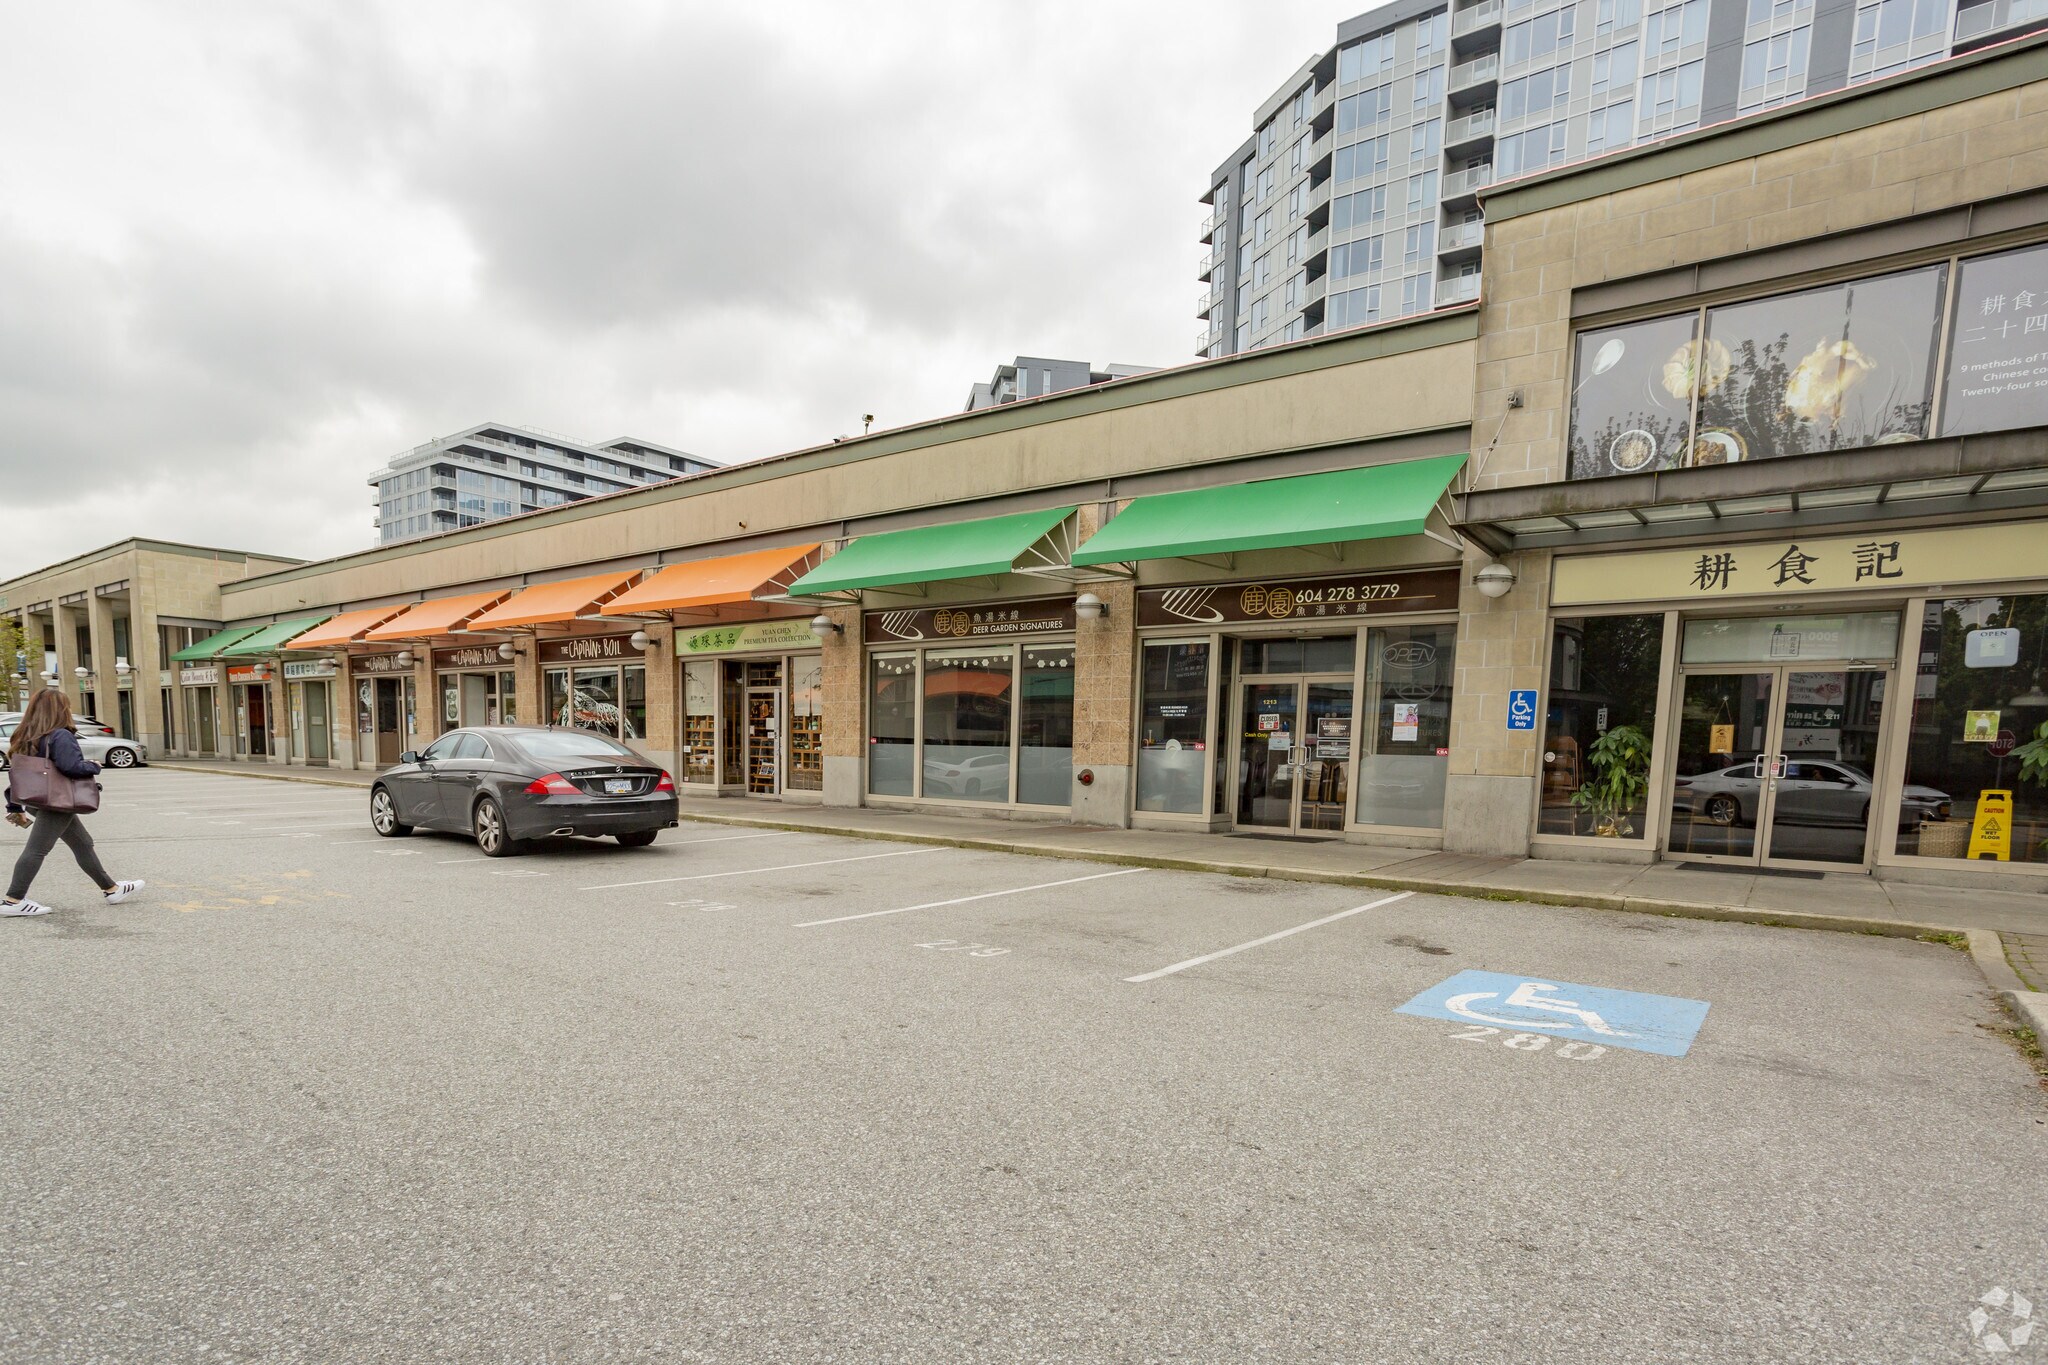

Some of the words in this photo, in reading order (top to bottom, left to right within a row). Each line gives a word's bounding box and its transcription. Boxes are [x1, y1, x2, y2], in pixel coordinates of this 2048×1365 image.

[1961, 365, 1968, 373] 9
[1971, 358, 2022, 371] methods
[2025, 354, 2039, 363] of
[2040, 352, 2048, 361] T
[1983, 369, 2029, 382] Chinese
[2033, 366, 2048, 375] co
[1961, 382, 2031, 397] Twenty-four
[1690, 541, 1903, 591] 耕食記
[1241, 586, 1293, 617] 鹿園
[1296, 589, 1323, 603] 604
[1327, 587, 1355, 601] 278
[1361, 584, 1400, 599] 3779
[1296, 603, 1368, 617] 魚湯米線
[935, 611, 969, 635] 鹿園
[972, 625, 989, 634] DEER
[990, 622, 1018, 633] GARDEN
[1020, 620, 1063, 630] SIGNATURES
[561, 646, 569, 654] THE
[603, 638, 622, 656] BOIL
[744, 637, 767, 645] PREMIUM
[768, 636, 779, 644] TEA
[779, 634, 811, 643] COLLECTION
[484, 648, 498, 663] BOIL
[1383, 647, 1437, 662] OPEN
[1448, 1025, 1607, 1061] 280
